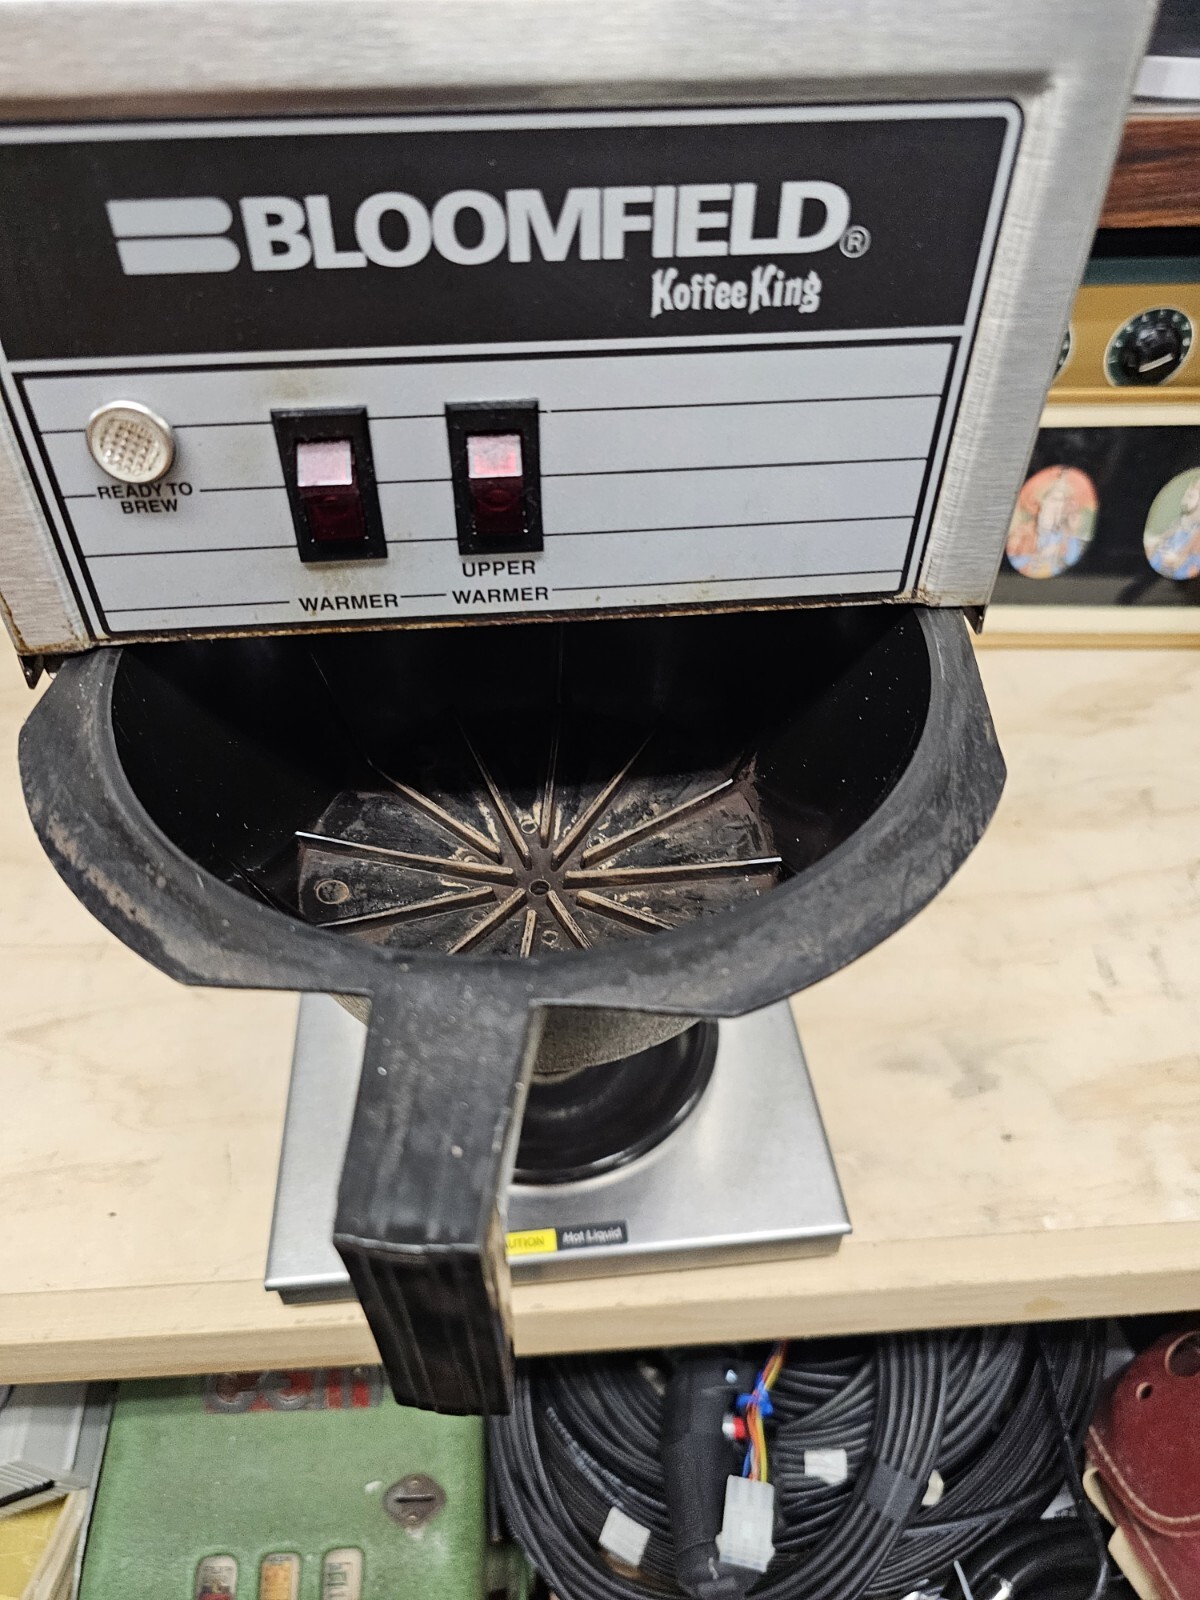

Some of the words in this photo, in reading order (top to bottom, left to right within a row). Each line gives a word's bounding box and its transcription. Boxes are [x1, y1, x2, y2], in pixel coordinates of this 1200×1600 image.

[651, 267, 748, 318] Koffee
[748, 263, 822, 315] King
[97, 482, 162, 499] READY
[166, 482, 193, 496] TO
[120, 499, 178, 514] BREW
[462, 560, 536, 577] UPPER
[298, 593, 399, 612] WARMER
[452, 587, 549, 604] WARMER
[506, 1235, 545, 1249] UTION
[562, 1231, 584, 1245] Hot
[585, 1226, 622, 1242] Liquid
